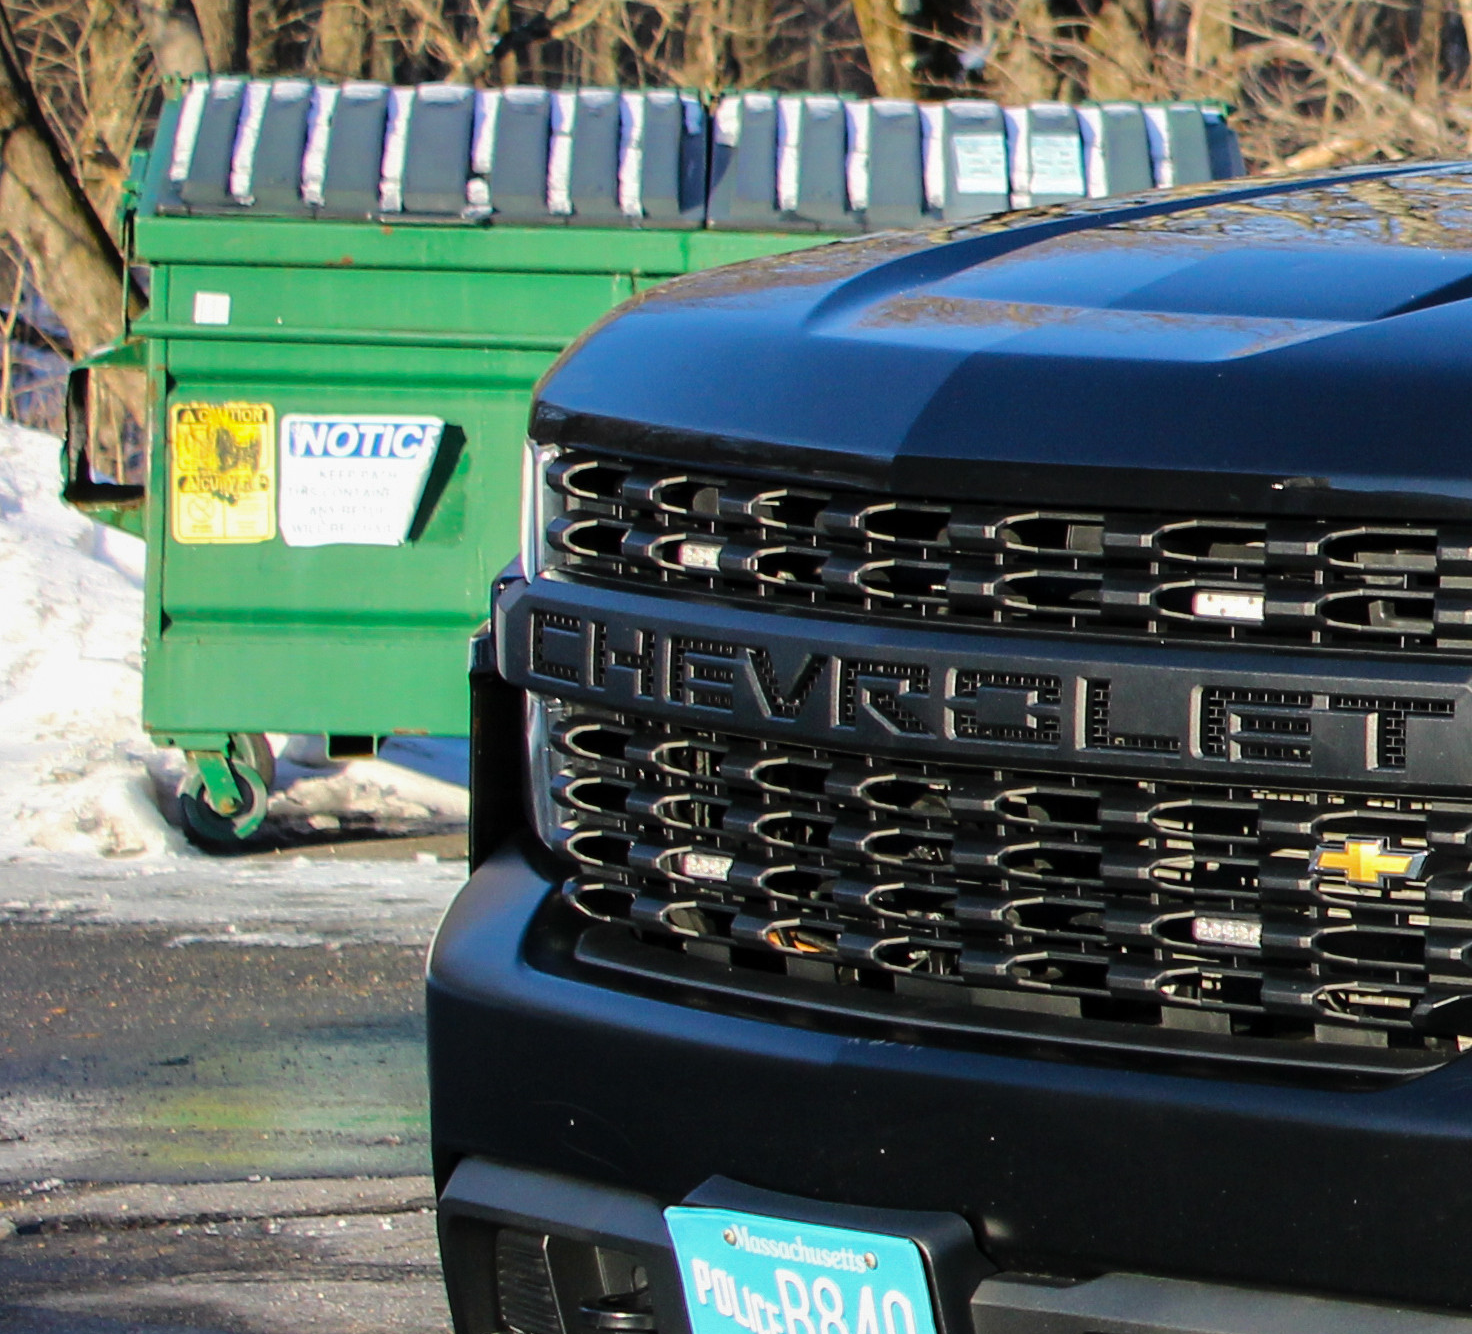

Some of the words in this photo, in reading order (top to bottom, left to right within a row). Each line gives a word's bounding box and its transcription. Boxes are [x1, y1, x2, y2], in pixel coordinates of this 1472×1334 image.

[199, 408, 264, 423] CTION
[529, 610, 1457, 771] CHEVROLET
[730, 1223, 868, 1274] Massachusetts
